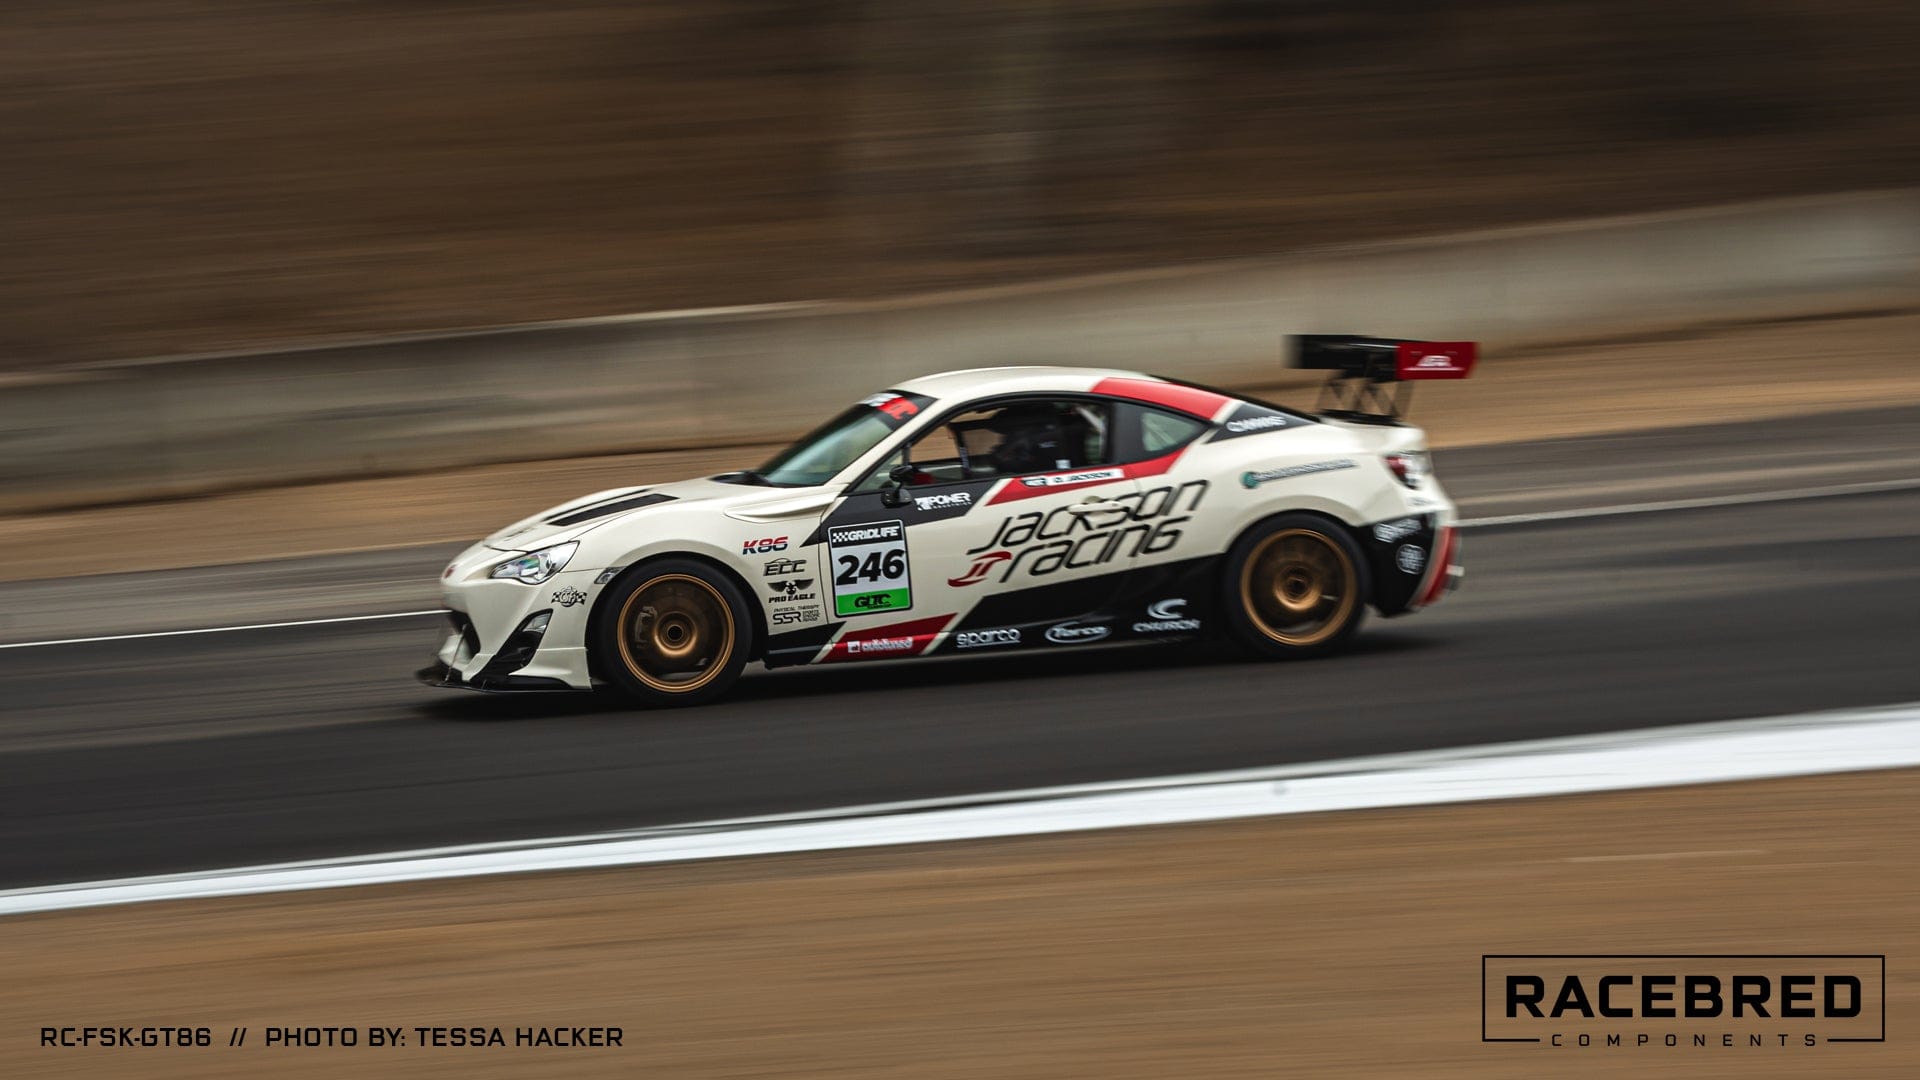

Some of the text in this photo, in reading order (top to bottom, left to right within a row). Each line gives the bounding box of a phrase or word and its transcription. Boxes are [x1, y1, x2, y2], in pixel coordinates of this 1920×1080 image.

[847, 526, 900, 541] GRIDLIFE
[742, 536, 788, 555] K86
[763, 559, 807, 577] ECC
[836, 549, 905, 586] 246
[788, 593, 816, 602] EAGLE
[772, 611, 802, 625] SSR
[956, 628, 1021, 648] sparco
